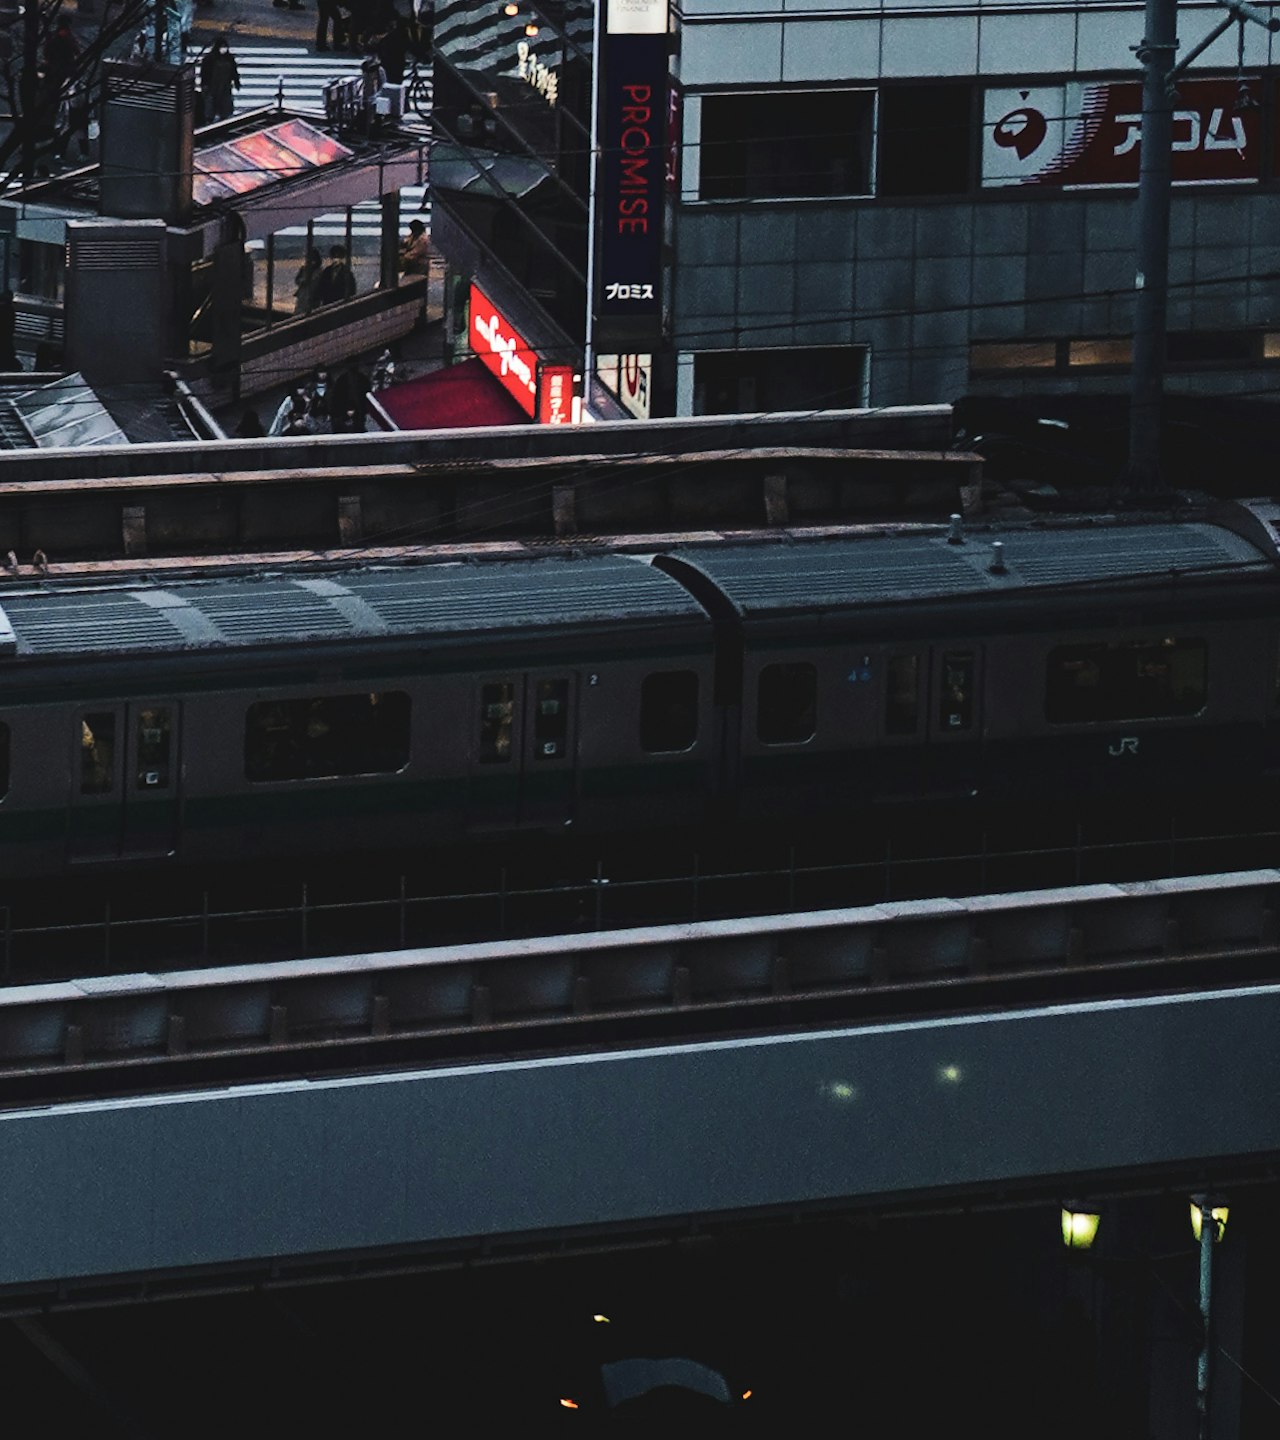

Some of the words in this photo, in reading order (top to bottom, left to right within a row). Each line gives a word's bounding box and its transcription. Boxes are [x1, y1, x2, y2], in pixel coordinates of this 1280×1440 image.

[618, 84, 652, 235] PROMISE
[605, 283, 655, 301] プロミス
[1108, 736, 1140, 757] JR
